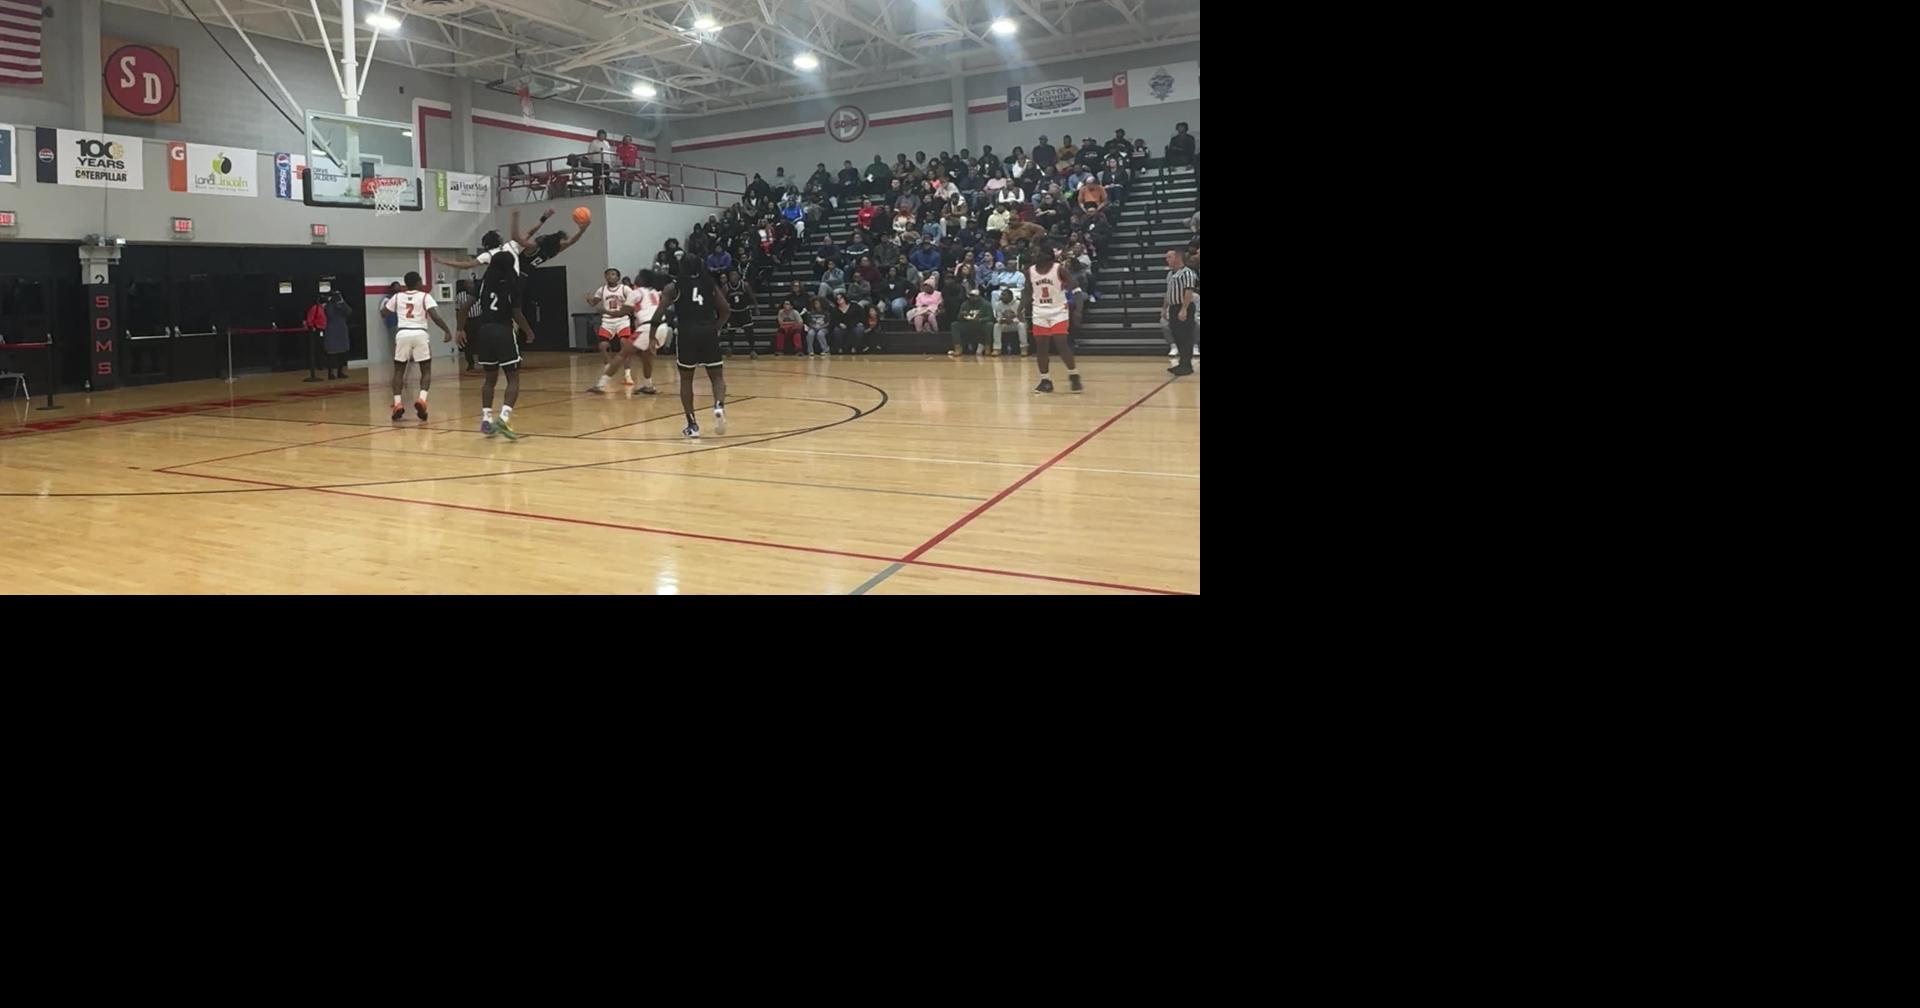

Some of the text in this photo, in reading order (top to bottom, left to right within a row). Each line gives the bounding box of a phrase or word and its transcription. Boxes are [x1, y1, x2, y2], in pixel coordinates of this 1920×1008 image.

[1114, 74, 1126, 86] G
[1033, 87, 1072, 97] CUSTOM
[171, 146, 185, 160] G
[77, 156, 125, 170] YEARS
[75, 169, 127, 182] CATERPILLAR
[489, 292, 499, 311] 2
[692, 287, 704, 306] 4
[405, 303, 415, 318] 2
